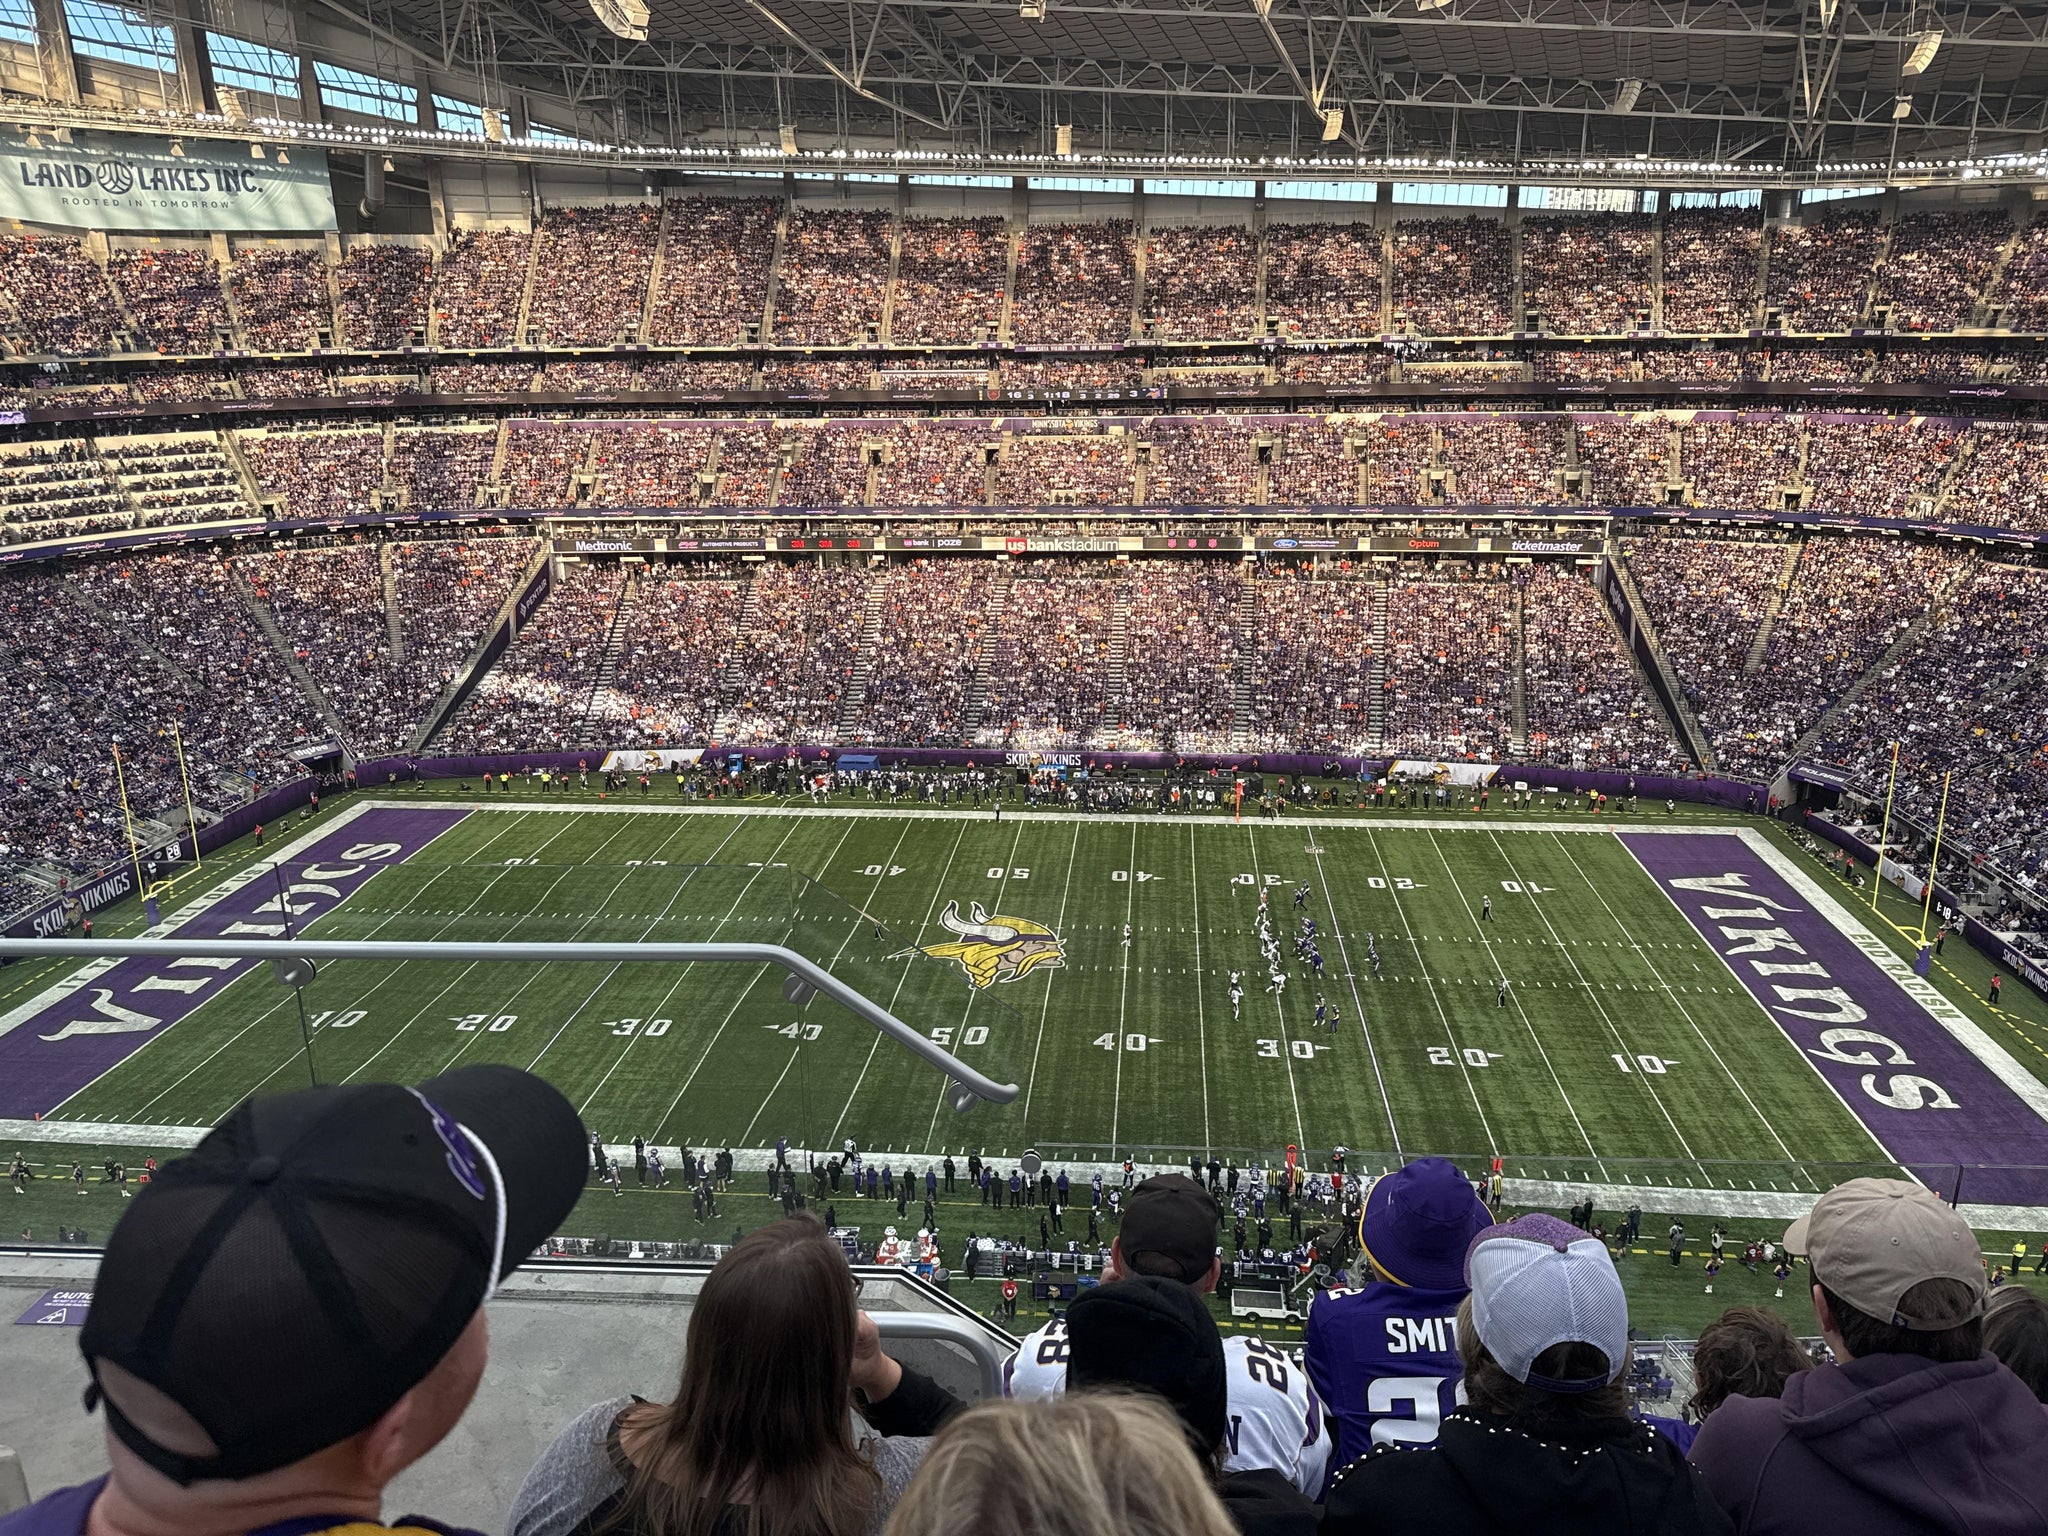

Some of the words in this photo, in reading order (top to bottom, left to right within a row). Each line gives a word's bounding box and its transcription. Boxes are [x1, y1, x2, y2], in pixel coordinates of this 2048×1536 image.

[20, 161, 92, 188] LAND
[216, 168, 264, 193] INC.
[62, 197, 120, 207] ROOTED
[129, 199, 143, 207] IN
[152, 200, 229, 209] TOMORROW
[1129, 390, 1138, 398] 3
[1074, 419, 1098, 428] VIKINGS
[1226, 416, 1244, 426] SKOL
[576, 540, 632, 550] Medtronic
[791, 540, 804, 548] 3M
[819, 540, 832, 548] 3M
[847, 540, 860, 548] 3M
[937, 539, 961, 548] paze
[1409, 540, 1439, 549] Optum
[1512, 540, 1583, 551] ticketmaster
[1043, 753, 1081, 765] VIKINGS
[1798, 766, 1845, 782] POLARIS
[167, 844, 181, 860] 28
[865, 865, 907, 876] 40
[987, 868, 1030, 879] 50
[1112, 870, 1153, 882] 40
[1239, 874, 1282, 885] 30
[1367, 877, 1415, 889] 20
[80, 871, 131, 912] VIKINGS
[1501, 881, 1542, 893] 10
[57, 977, 89, 990] IT
[163, 906, 208, 926] ALL
[209, 886, 233, 899] OF
[231, 869, 265, 882] US
[1849, 932, 1892, 959] END
[1882, 962, 1962, 1020] RACISM
[1668, 872, 1962, 1109] VIKINGS
[311, 1010, 369, 1028] 10
[455, 1013, 519, 1032] 20
[611, 1018, 673, 1037] 30
[929, 1026, 990, 1047] 50
[1093, 1033, 1147, 1052] 40
[1256, 1039, 1314, 1059] 30
[1427, 1047, 1489, 1067] 20
[1611, 1054, 1668, 1074] 10
[1263, 1249, 1273, 1258] 93
[1282, 1254, 1292, 1262] 97
[1386, 1317, 1460, 1353] SMIT
